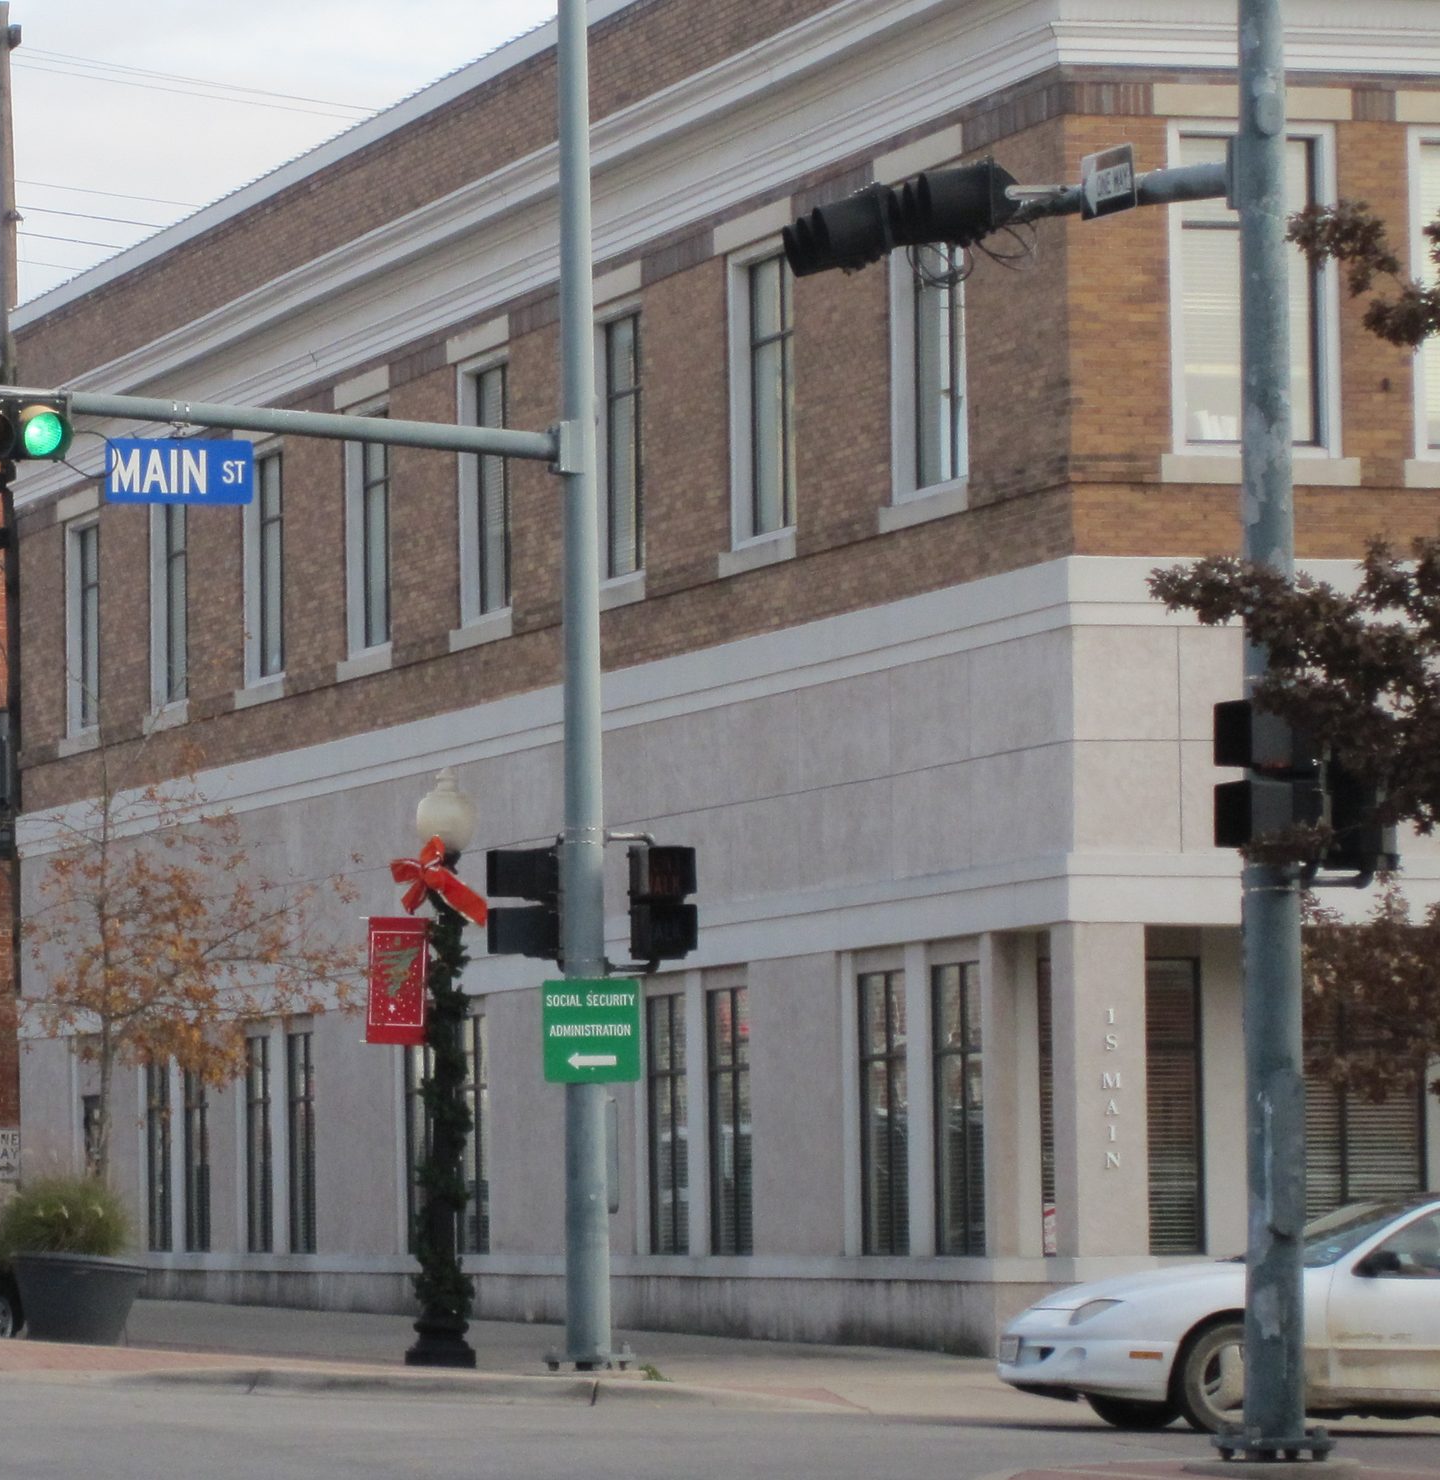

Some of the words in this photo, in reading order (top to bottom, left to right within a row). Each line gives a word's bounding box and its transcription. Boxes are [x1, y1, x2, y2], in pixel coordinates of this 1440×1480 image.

[1096, 170, 1112, 197] ONE
[1114, 164, 1131, 193] WAY
[111, 448, 207, 494] MAIN
[222, 460, 246, 484] ST
[546, 994, 582, 1007] SOCIAL
[586, 993, 635, 1006] SECURITY
[1106, 1008, 1115, 1025] 1
[549, 1024, 631, 1037] ADMINISTRATION
[1101, 1071, 1122, 1169] MAIN
